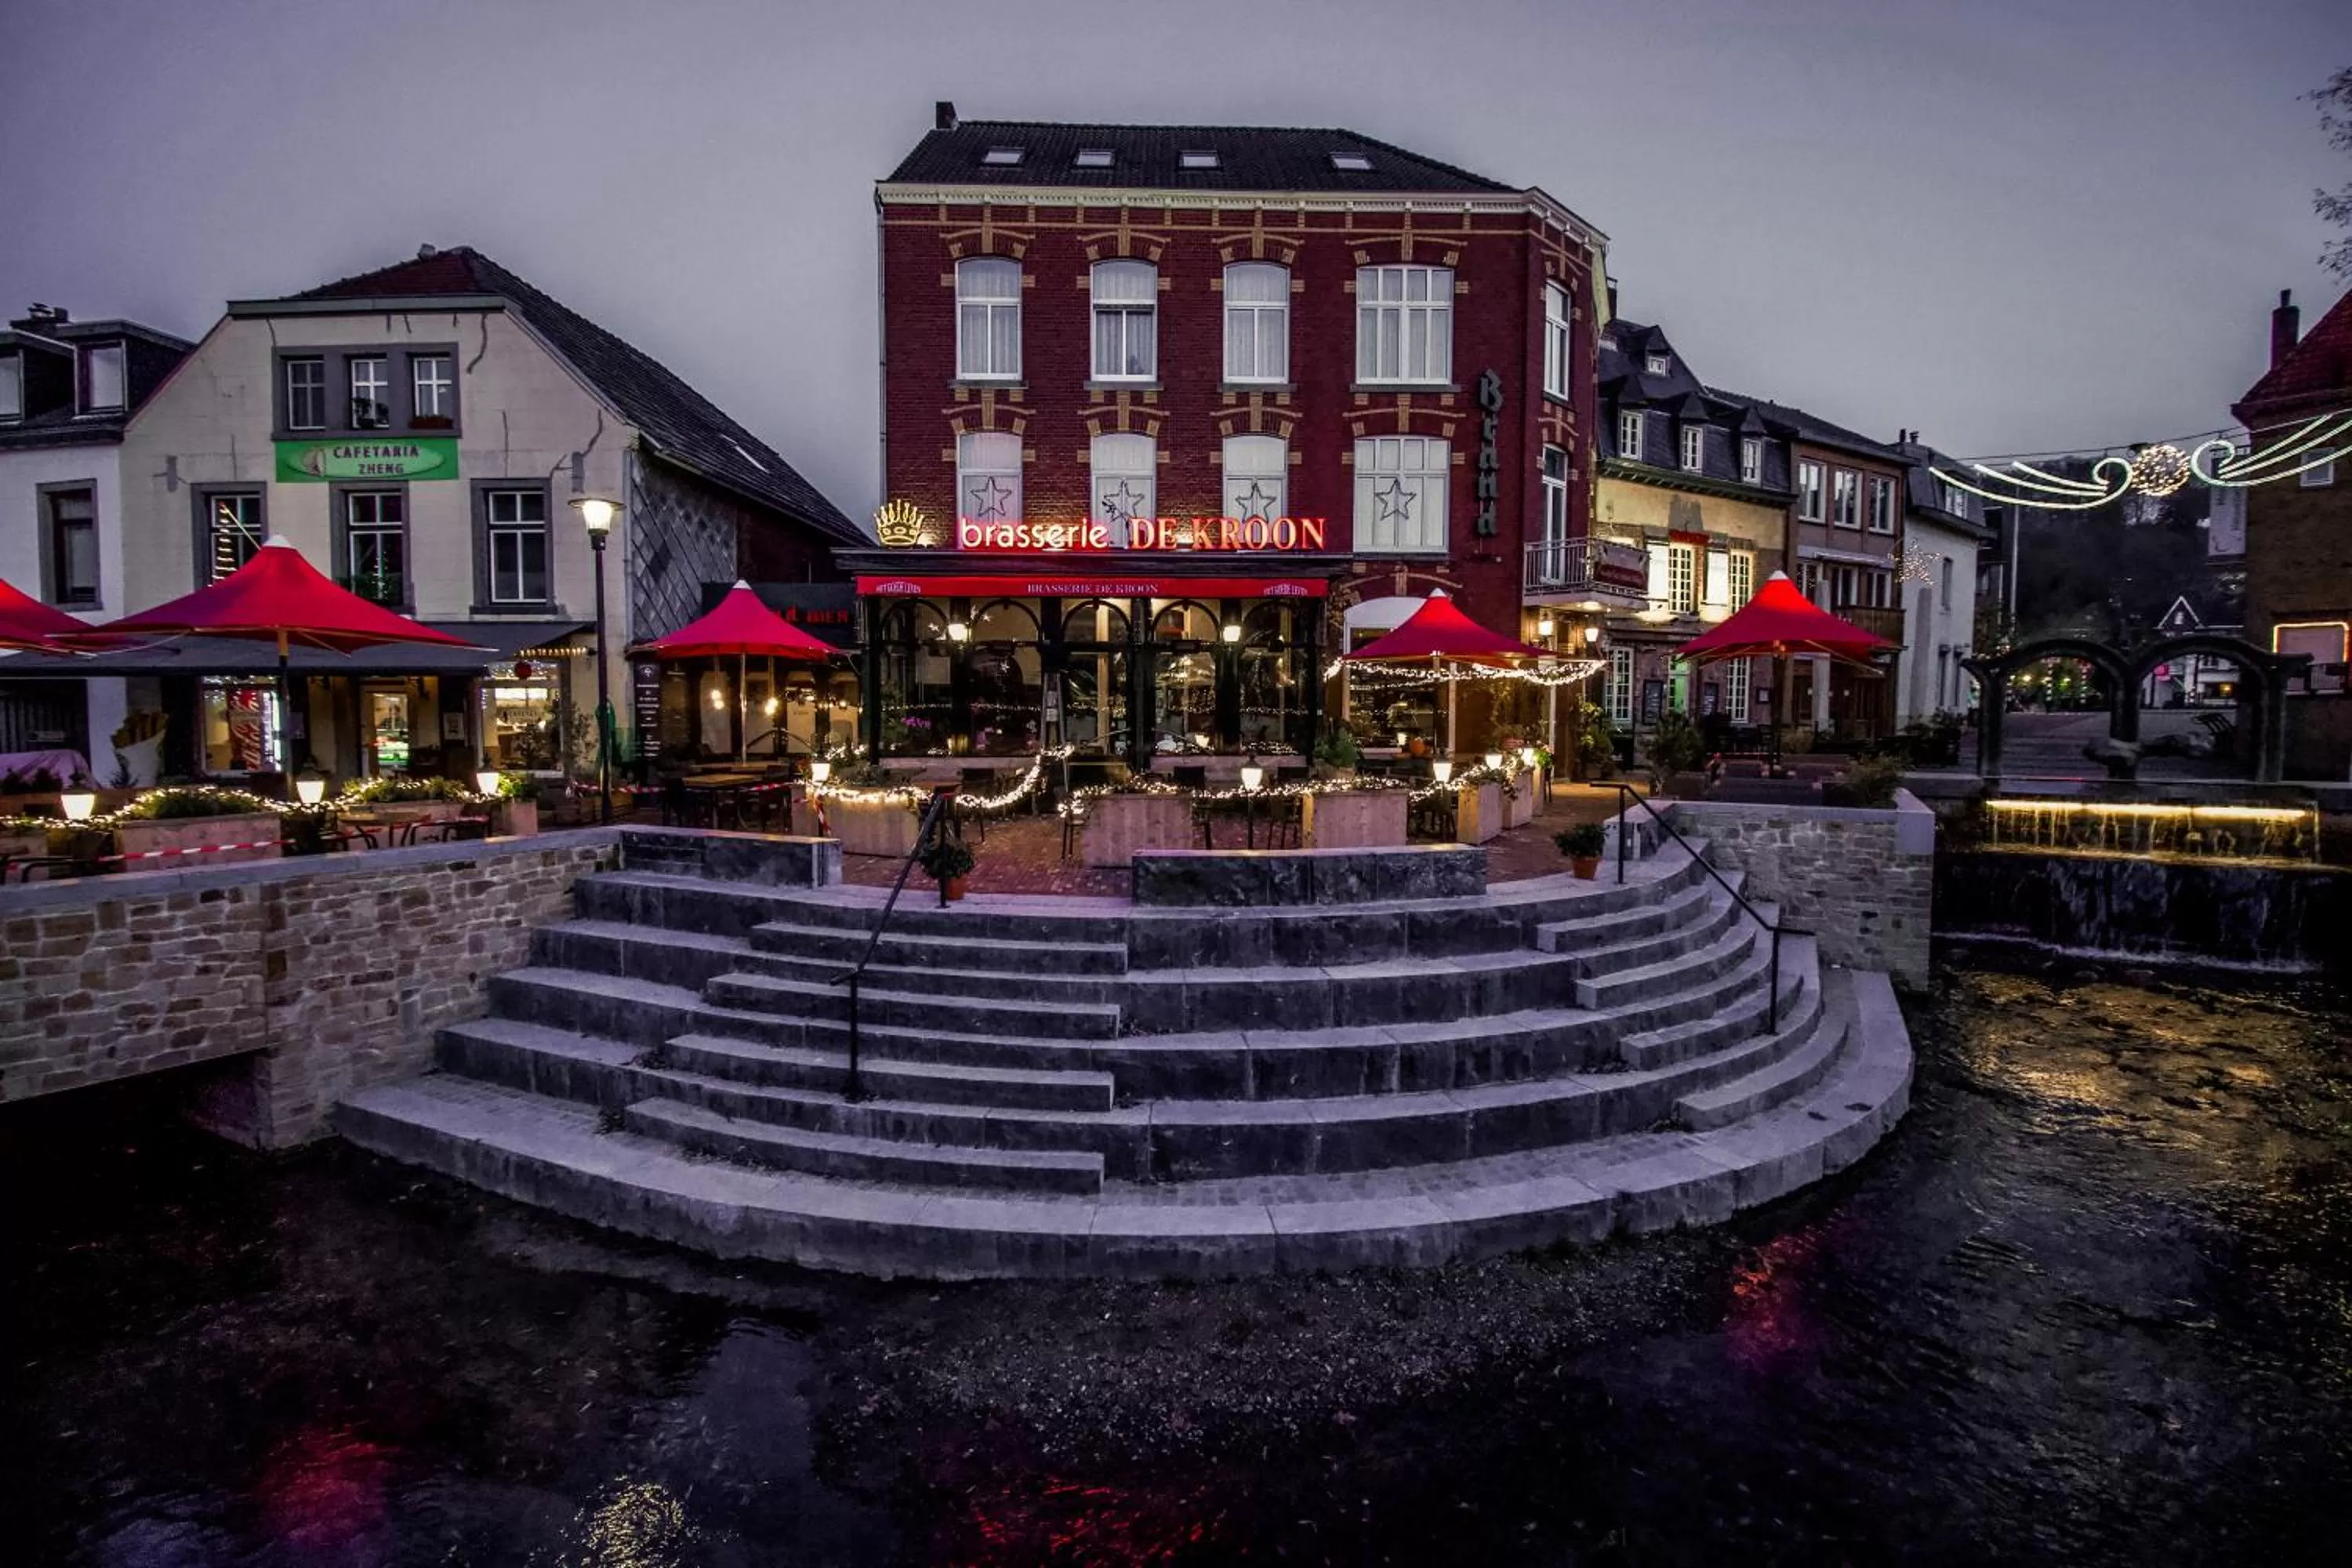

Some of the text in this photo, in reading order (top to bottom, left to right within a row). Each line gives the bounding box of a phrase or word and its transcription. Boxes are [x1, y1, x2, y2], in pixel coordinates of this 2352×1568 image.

[332, 445, 420, 459] CAFETARIA
[1478, 368, 1504, 535] Brand
[358, 463, 405, 474] ZHENG
[960, 517, 1326, 550] brasserie DE KROON
[1028, 584, 1159, 593] BRASSERIE DE KROON
